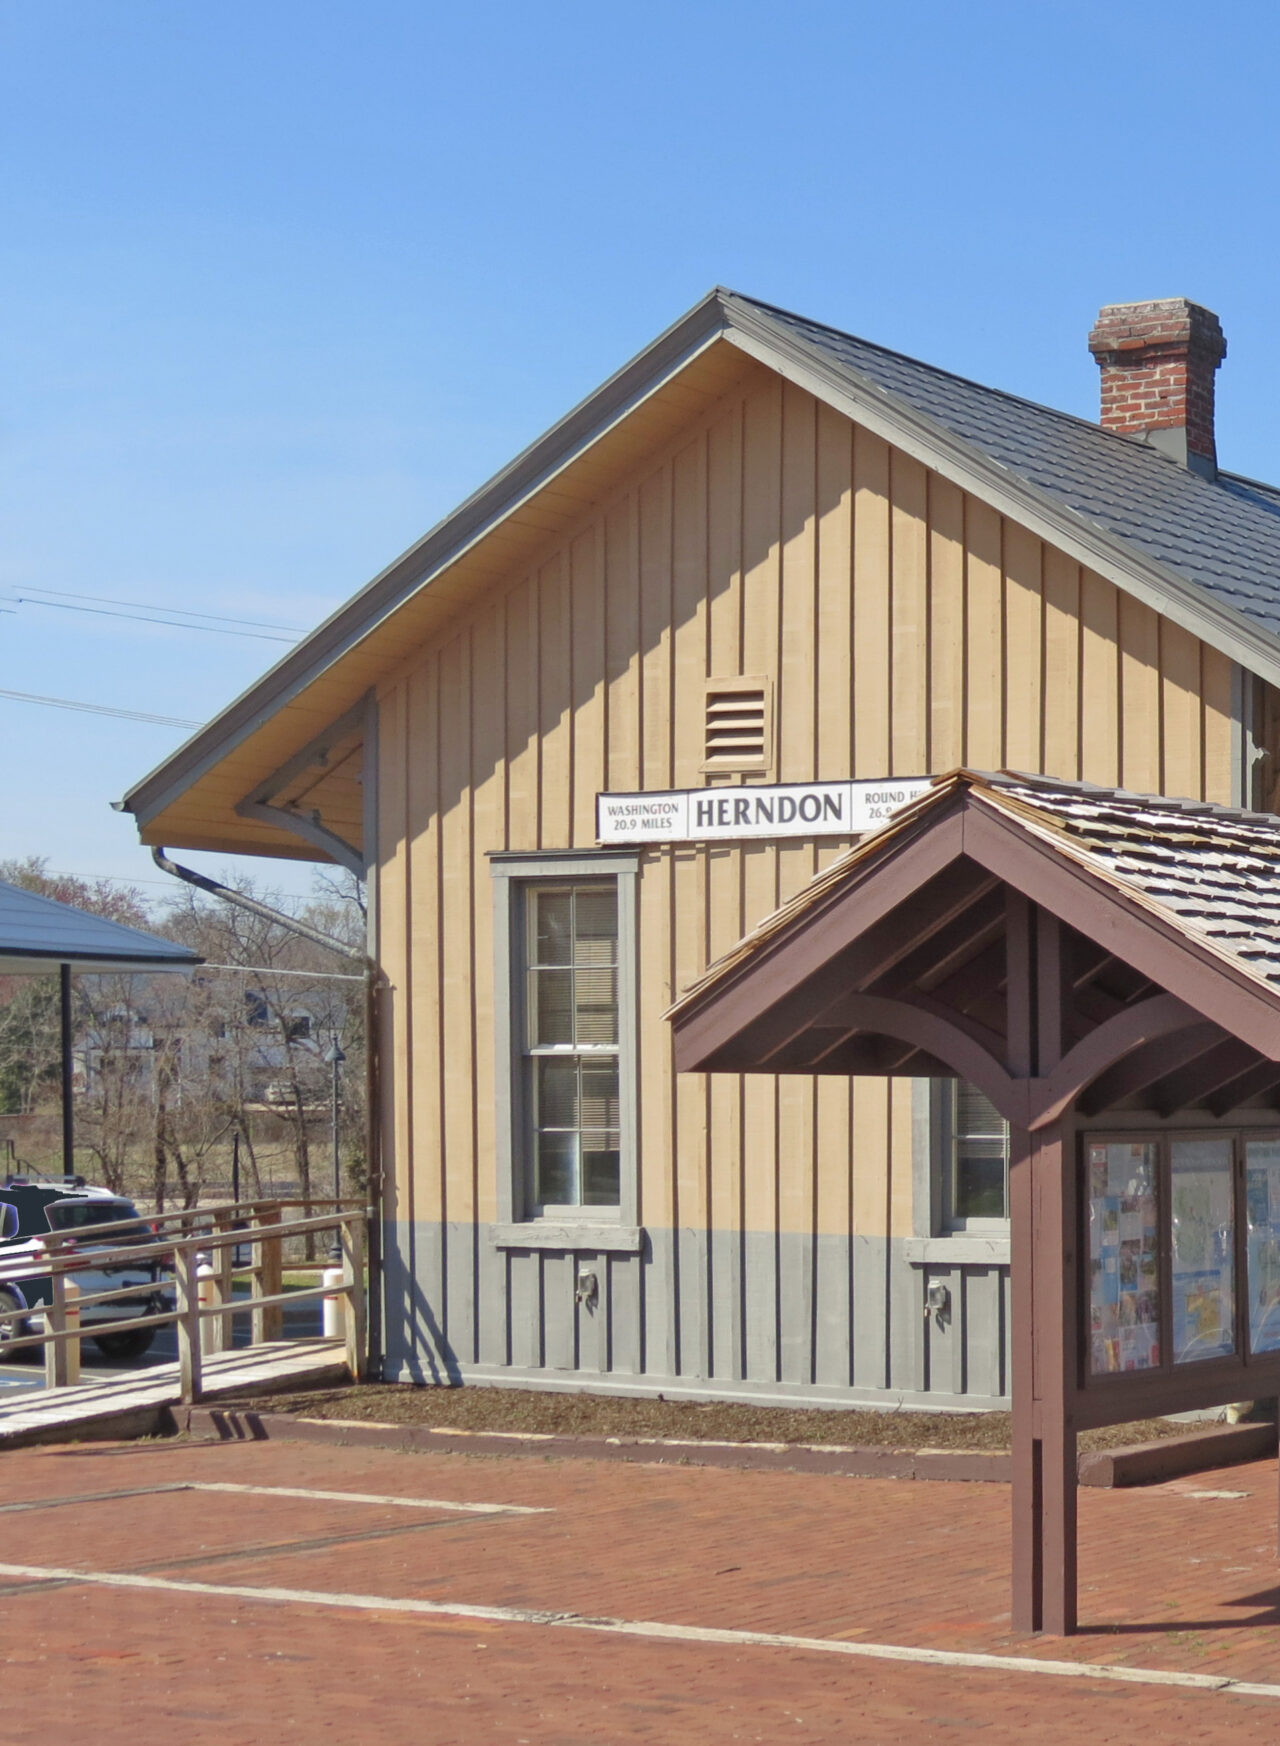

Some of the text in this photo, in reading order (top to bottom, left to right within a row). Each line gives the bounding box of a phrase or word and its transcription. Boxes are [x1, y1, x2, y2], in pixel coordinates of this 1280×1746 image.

[865, 791, 905, 804] ROUND
[607, 803, 679, 816] WASHINGTON
[696, 793, 842, 827] HERNDON
[614, 817, 672, 831] 20.9 MILES
